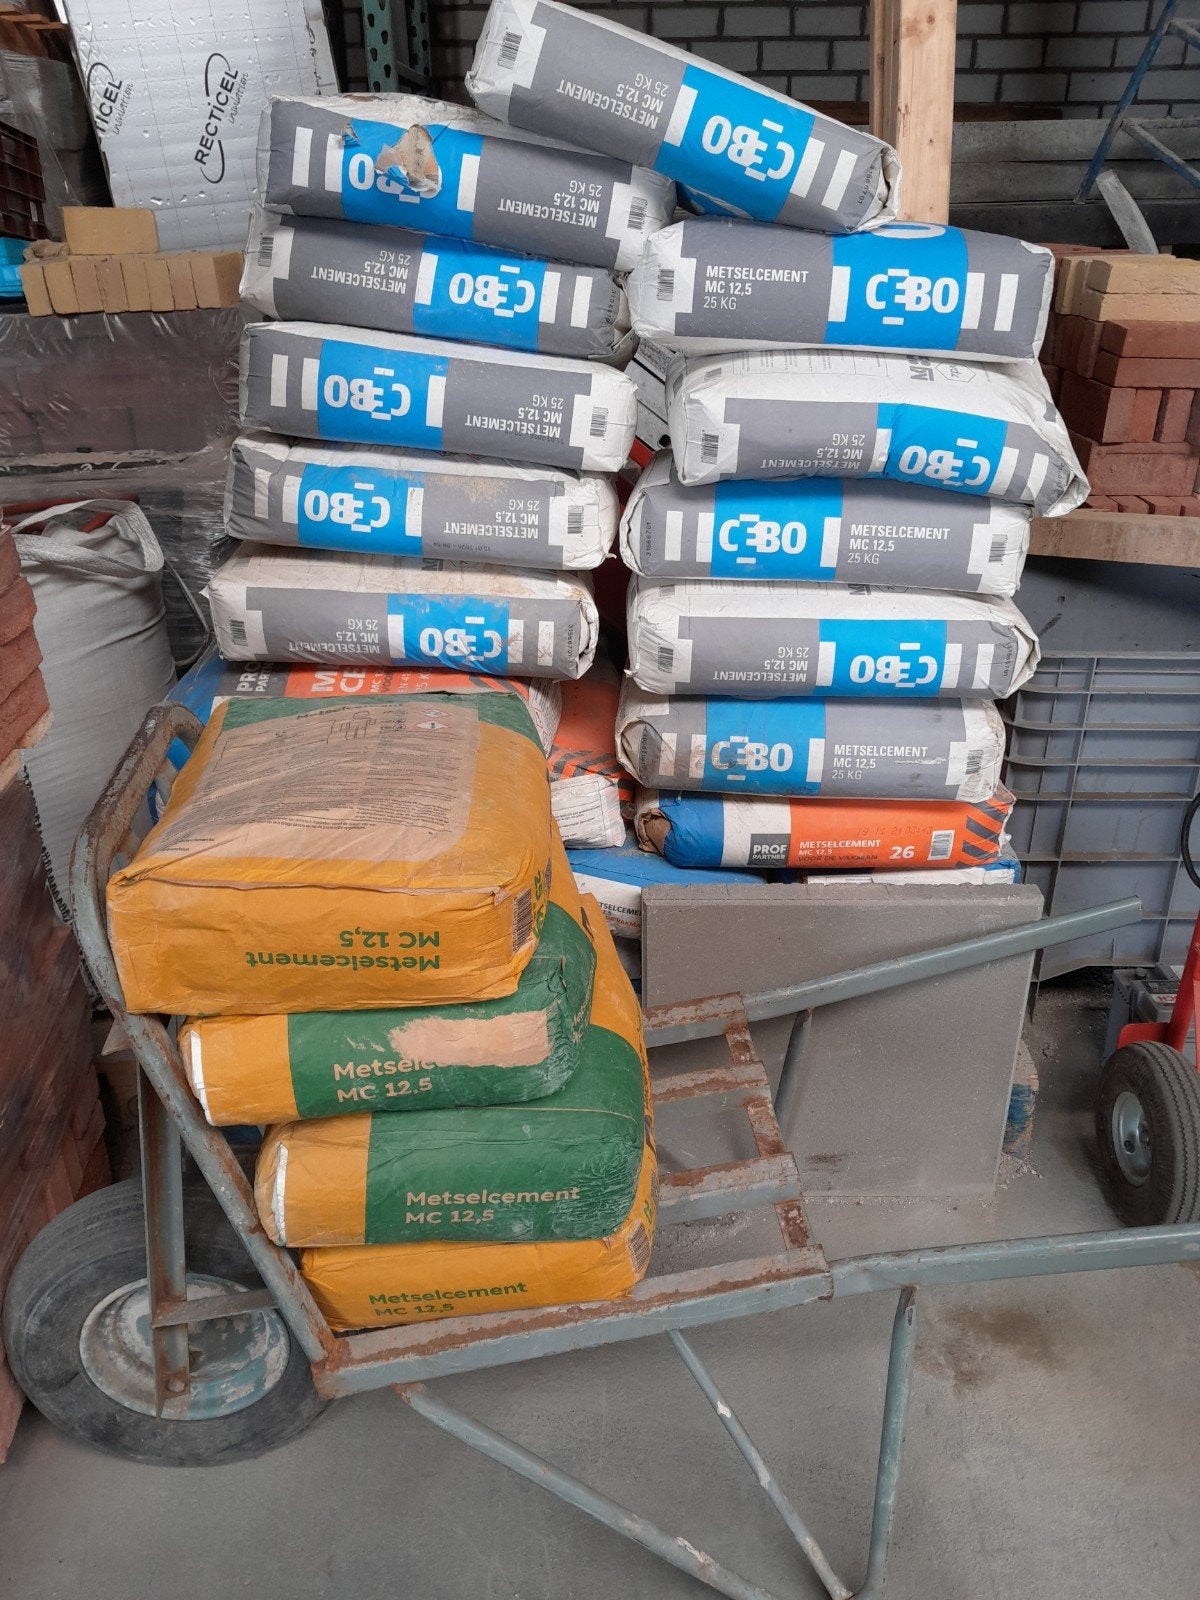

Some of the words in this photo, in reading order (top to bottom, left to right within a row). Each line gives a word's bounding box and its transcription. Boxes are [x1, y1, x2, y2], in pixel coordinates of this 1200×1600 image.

[634, 73, 653, 87] KG
[616, 83, 645, 103] 12,5
[655, 84, 669, 97] 25
[556, 79, 659, 130] METSELCEMENT
[648, 95, 664, 114] MC
[569, 180, 585, 193] KG
[588, 185, 603, 197] 25
[553, 192, 577, 212] 12,5
[579, 197, 600, 213] MC
[497, 198, 598, 229] METSELCEMENT
[379, 250, 394, 262] KG
[398, 254, 411, 265] 25
[364, 261, 386, 276] 12,5
[390, 266, 408, 280] MC
[705, 265, 809, 284] METSELCEMENT
[310, 266, 406, 294] METSELCEMENT
[704, 280, 725, 295] MC
[728, 282, 752, 296] 12,5
[703, 295, 717, 309] 25
[719, 297, 737, 310] KG
[532, 394, 549, 406] KG
[551, 398, 564, 409] 25
[518, 407, 539, 422] 12,5
[542, 413, 562, 425] MC
[464, 414, 561, 438] METSELCEMENT
[832, 433, 847, 445] KG
[848, 434, 865, 446] 25
[816, 446, 839, 460] 12,5
[842, 448, 863, 460] MC
[759, 457, 860, 470] METSELCEMENT
[508, 498, 524, 511] KG
[527, 500, 540, 511] 25
[495, 511, 519, 525] 12,5
[522, 512, 539, 525] MC
[443, 521, 539, 539] METSELCEMENT
[850, 524, 950, 541] METSELCEMENT
[849, 537, 869, 551] MC
[871, 539, 895, 552] 12,5
[847, 552, 862, 564] 25
[863, 552, 880, 565] KG
[347, 618, 363, 630] KG
[364, 618, 378, 630] 25
[336, 631, 355, 643] 12,5
[359, 632, 379, 643] MC
[289, 640, 380, 655] METSELCEMENT
[778, 646, 794, 657] KG
[795, 646, 809, 657] 25
[764, 658, 786, 670] 12,5
[788, 659, 808, 671] MC
[712, 671, 807, 683] METSELCEMENT
[834, 744, 929, 758] METSELCEMENT
[833, 757, 851, 768] MC
[854, 758, 876, 770] 12,5
[831, 768, 846, 779] 25
[846, 769, 862, 780] KG
[753, 844, 788, 854] PROF
[799, 839, 881, 849] METSELCEMENT
[889, 845, 916, 860] 26
[339, 926, 389, 949] 12,5
[399, 930, 441, 949] MC
[246, 951, 441, 972] Metselcement
[337, 1084, 377, 1103] MC
[385, 1077, 433, 1098] 12,5
[405, 1186, 581, 1207] Metselcement
[404, 1211, 442, 1225] MC
[450, 1209, 495, 1224] 12,5
[368, 1282, 529, 1306] Metselcement
[375, 1307, 408, 1317] MC
[413, 1304, 455, 1315] 12,5
